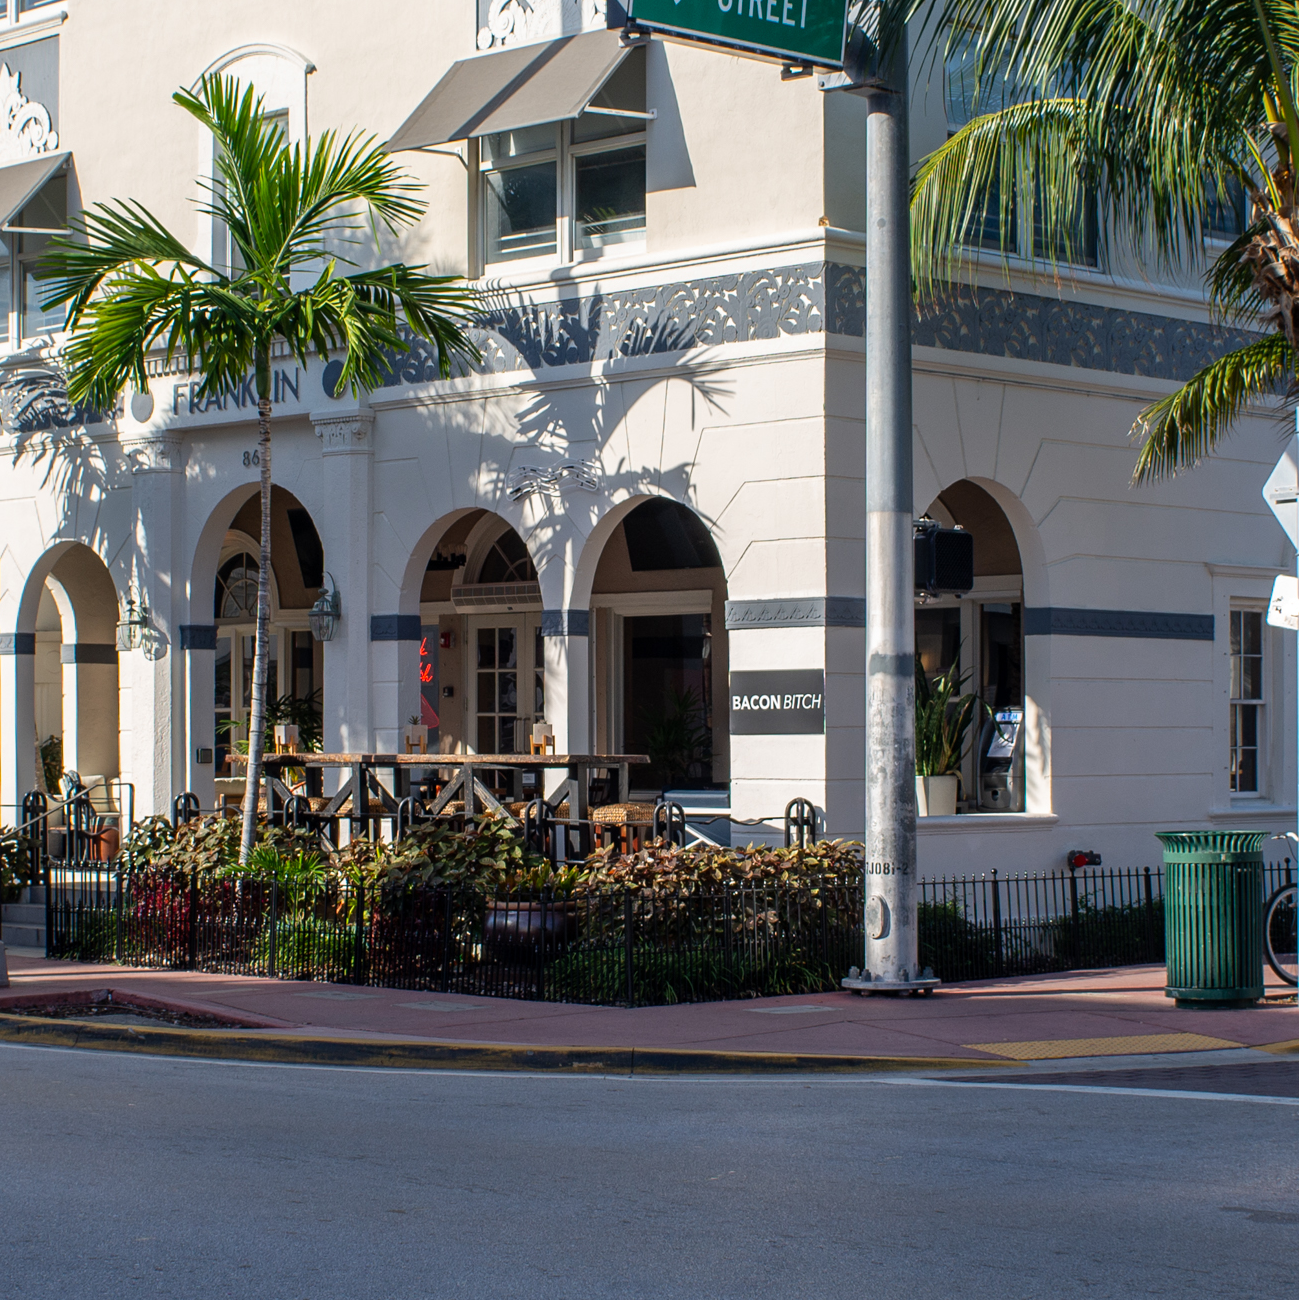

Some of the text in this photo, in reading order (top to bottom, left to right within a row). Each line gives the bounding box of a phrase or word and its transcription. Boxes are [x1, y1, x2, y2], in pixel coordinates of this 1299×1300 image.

[173, 367, 300, 415] FRANKIN
[732, 693, 822, 710] BACON BITCH
[1001, 713, 1018, 721] ATM
